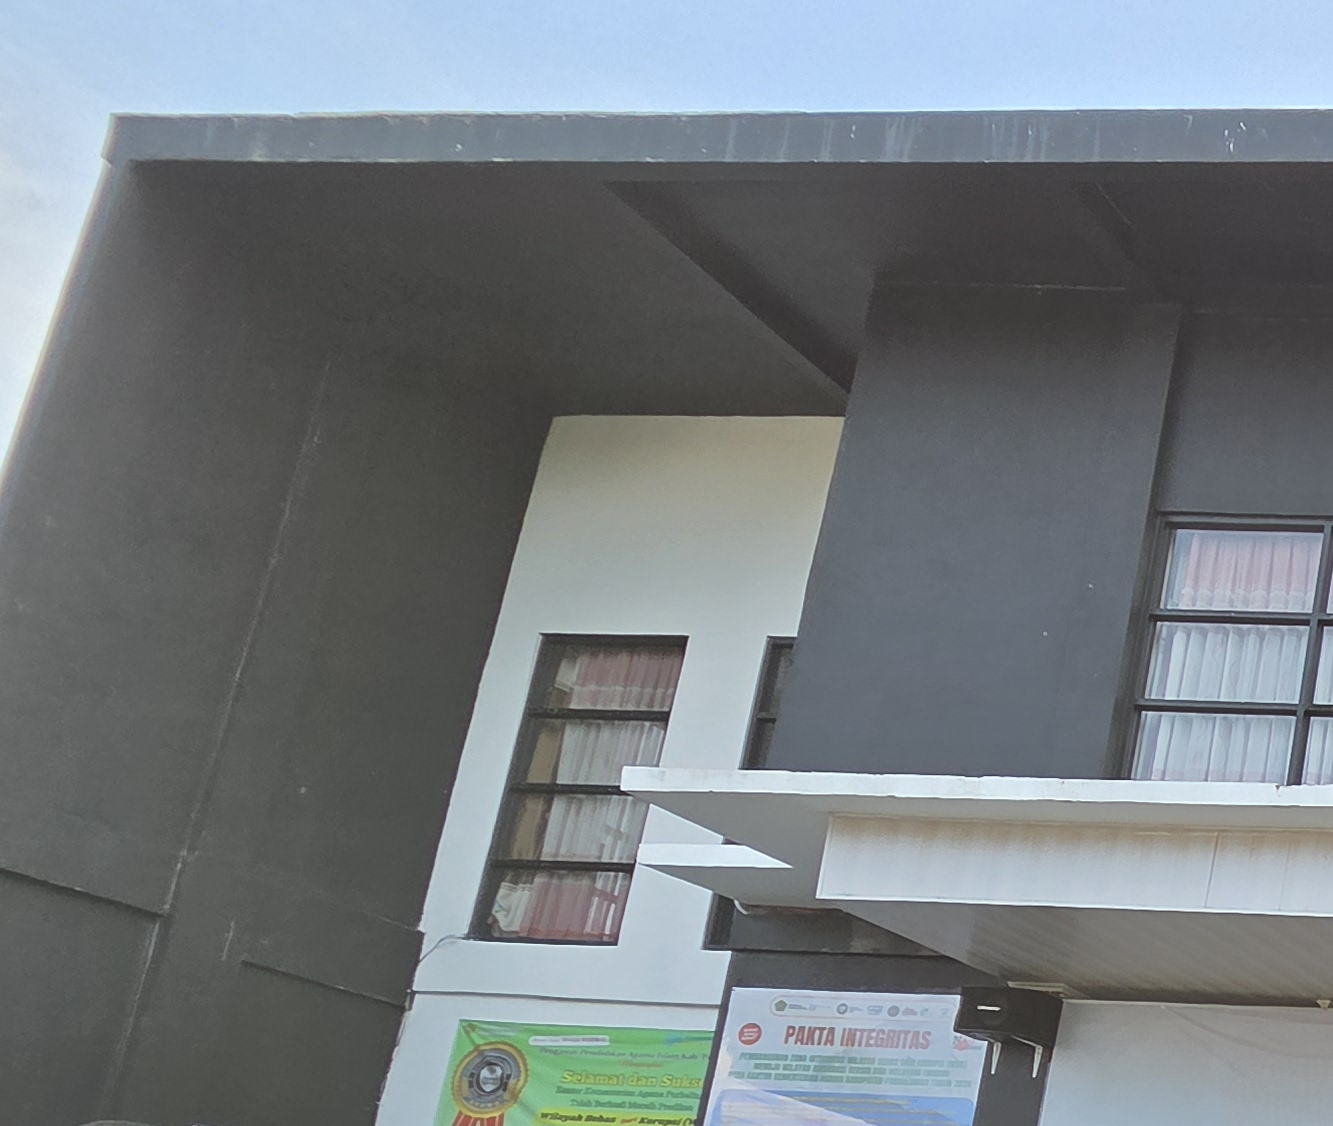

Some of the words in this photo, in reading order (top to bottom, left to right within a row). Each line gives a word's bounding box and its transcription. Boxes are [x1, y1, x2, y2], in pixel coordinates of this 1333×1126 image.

[784, 1025, 835, 1046] PAKTA
[840, 1027, 932, 1050] INTEGRITAS
[561, 1071, 624, 1086] Selamat
[627, 1072, 657, 1086] dan
[638, 1117, 681, 1126] Korupsi
